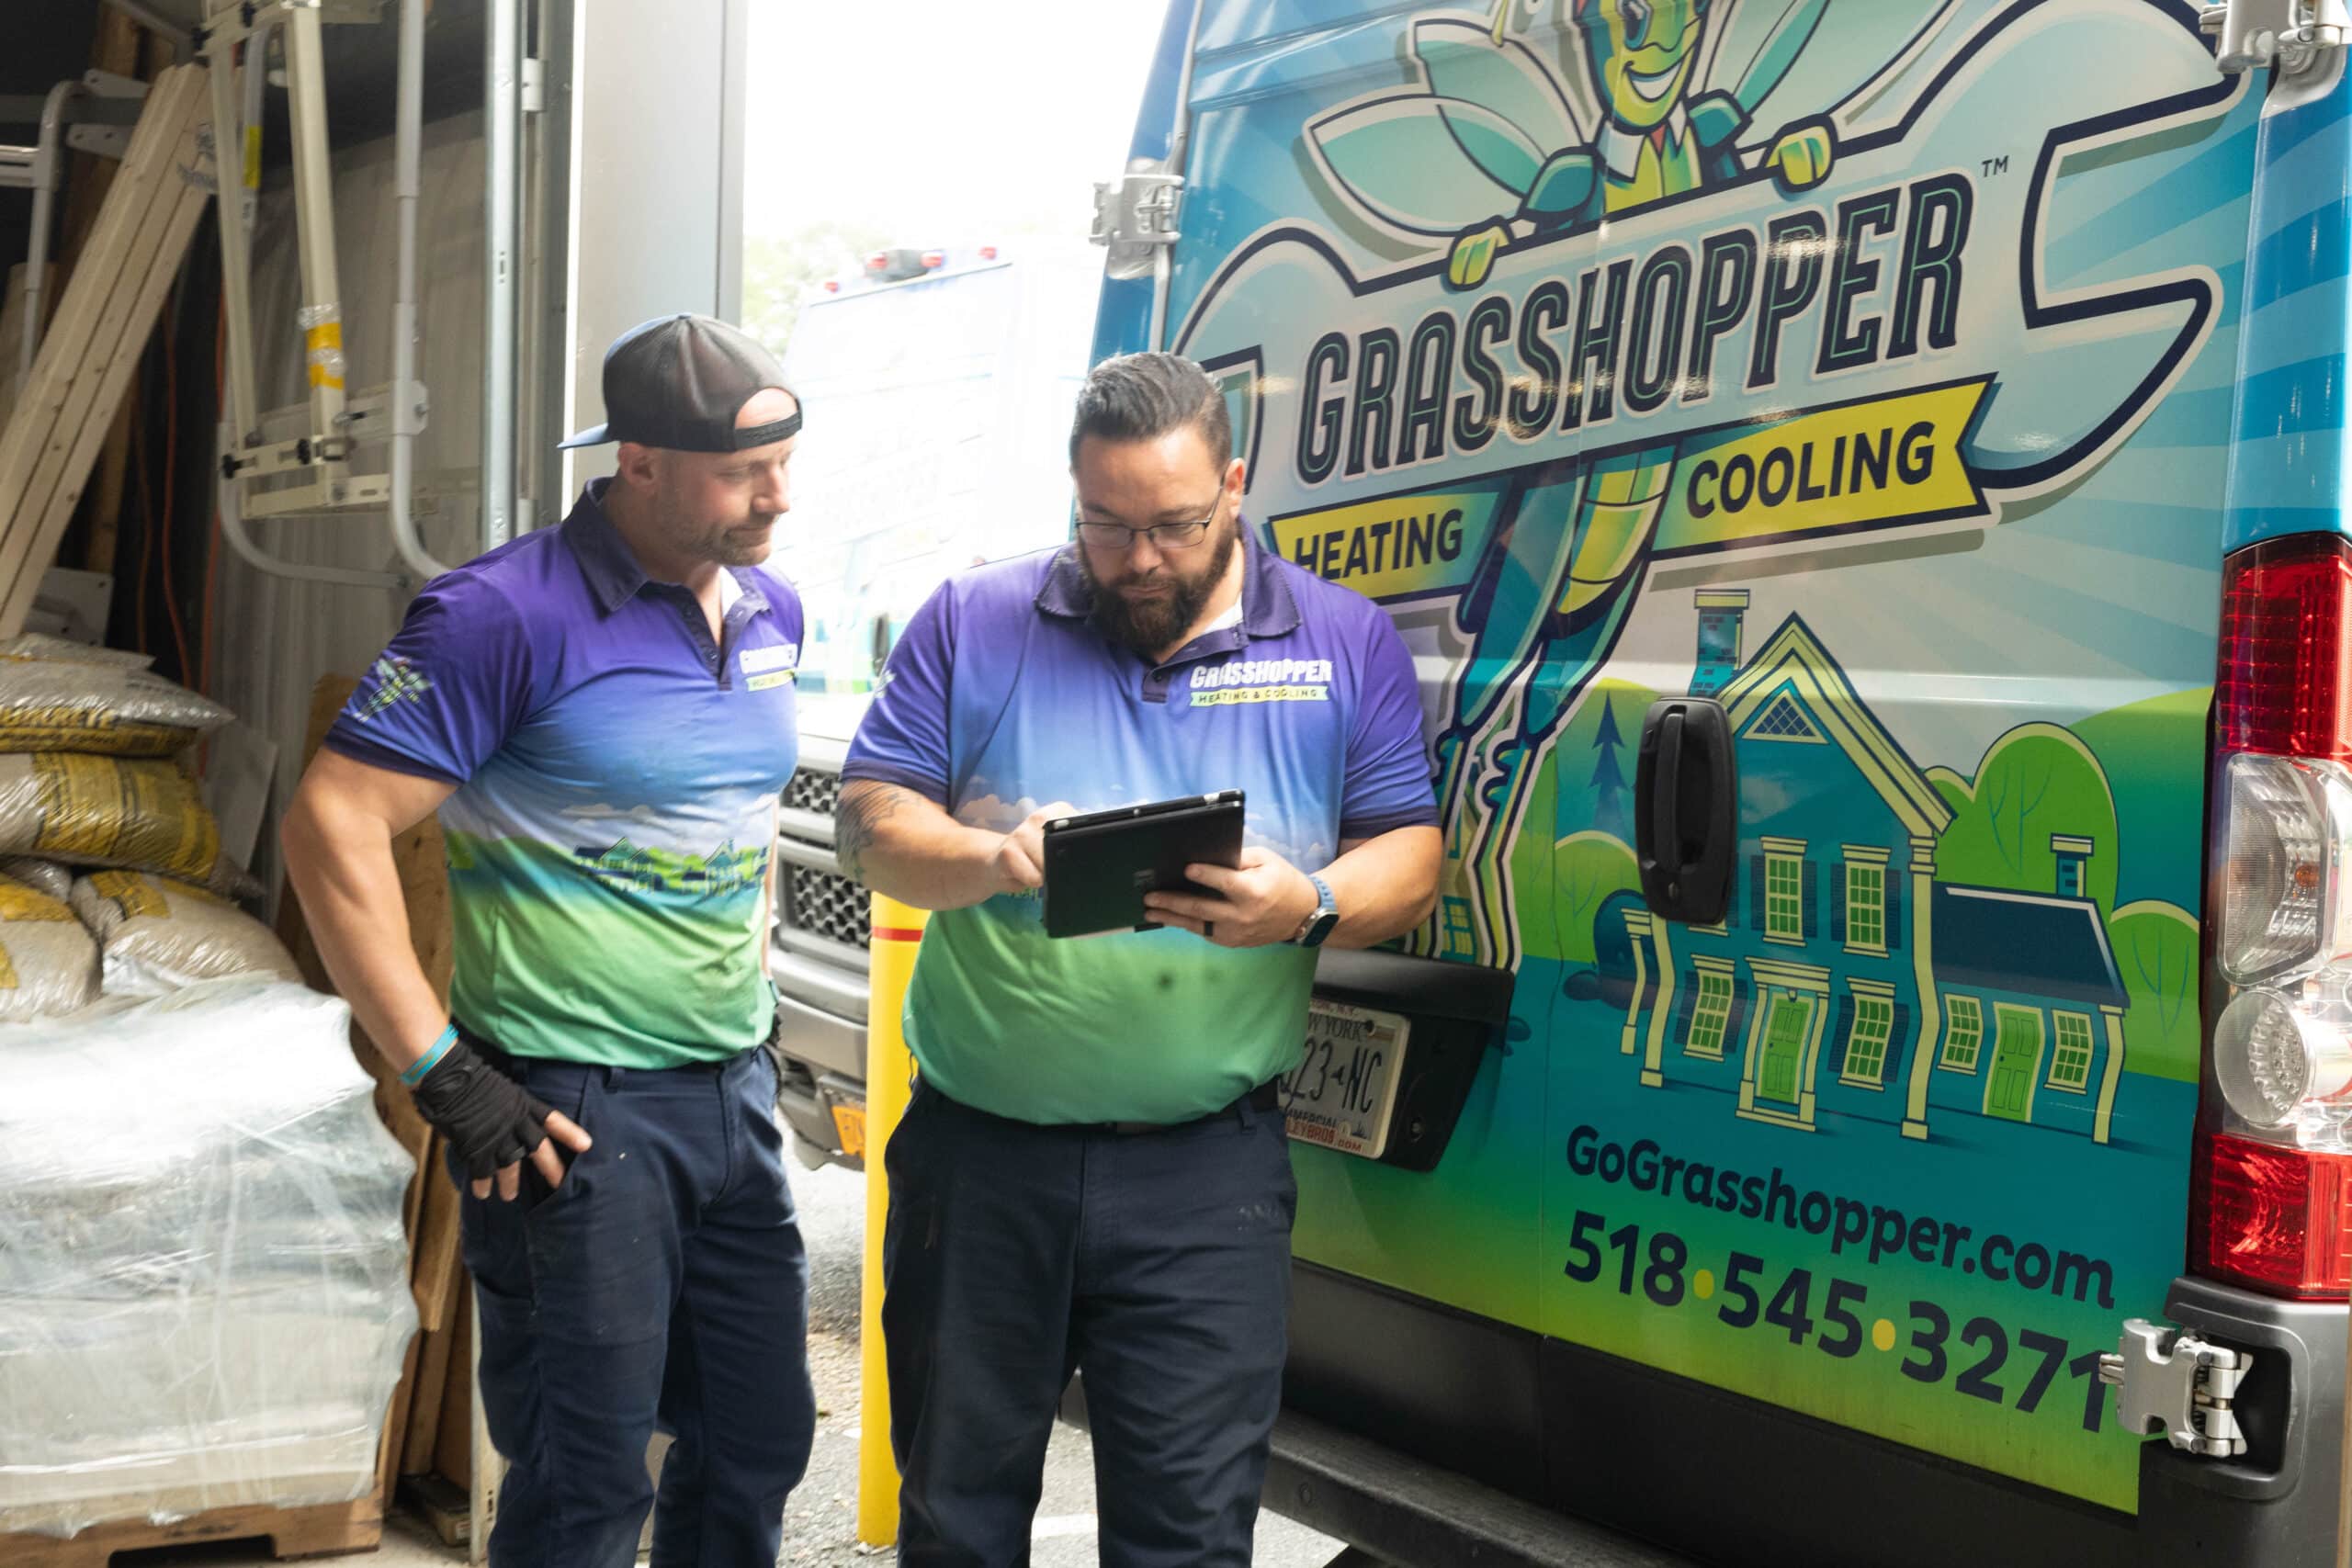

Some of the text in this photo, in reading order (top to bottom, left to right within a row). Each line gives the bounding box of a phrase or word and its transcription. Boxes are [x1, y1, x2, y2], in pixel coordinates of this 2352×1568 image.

[1296, 154, 2009, 480] GRASSHOPPER TM
[1687, 421, 1935, 519] COOLING
[1295, 508, 1464, 581] HEATING
[1190, 658, 1332, 689] GRASSHOPPER
[1198, 687, 1317, 705] HEATING & COOLING
[1324, 1015, 1366, 1043] YORK
[1566, 1125, 2115, 1309] GoGrasshopper.com
